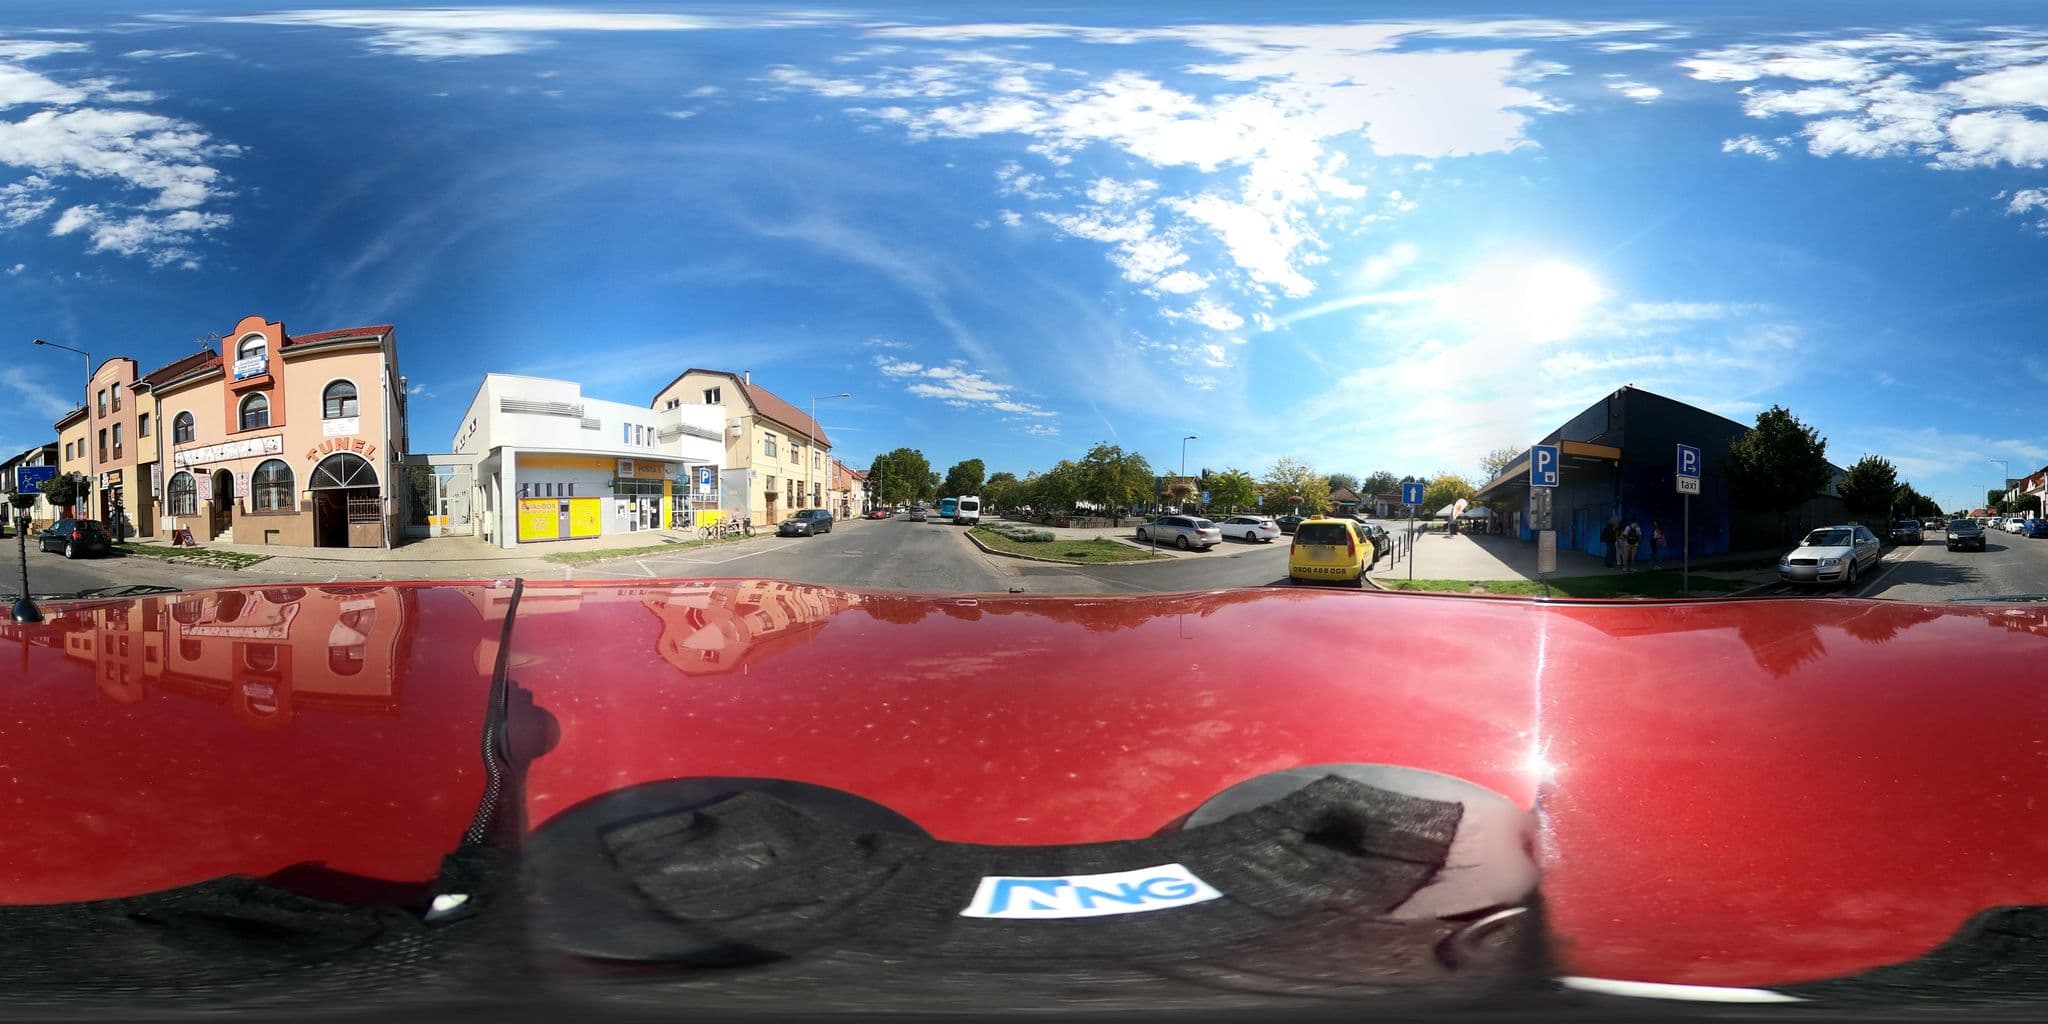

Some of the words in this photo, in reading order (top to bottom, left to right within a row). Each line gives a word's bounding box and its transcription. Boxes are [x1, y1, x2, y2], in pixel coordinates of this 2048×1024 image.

[306, 437, 376, 462] TUNEL
[1538, 450, 1551, 472] P
[1684, 450, 1695, 471] P
[702, 470, 709, 482] P
[1681, 480, 1697, 490] taxi
